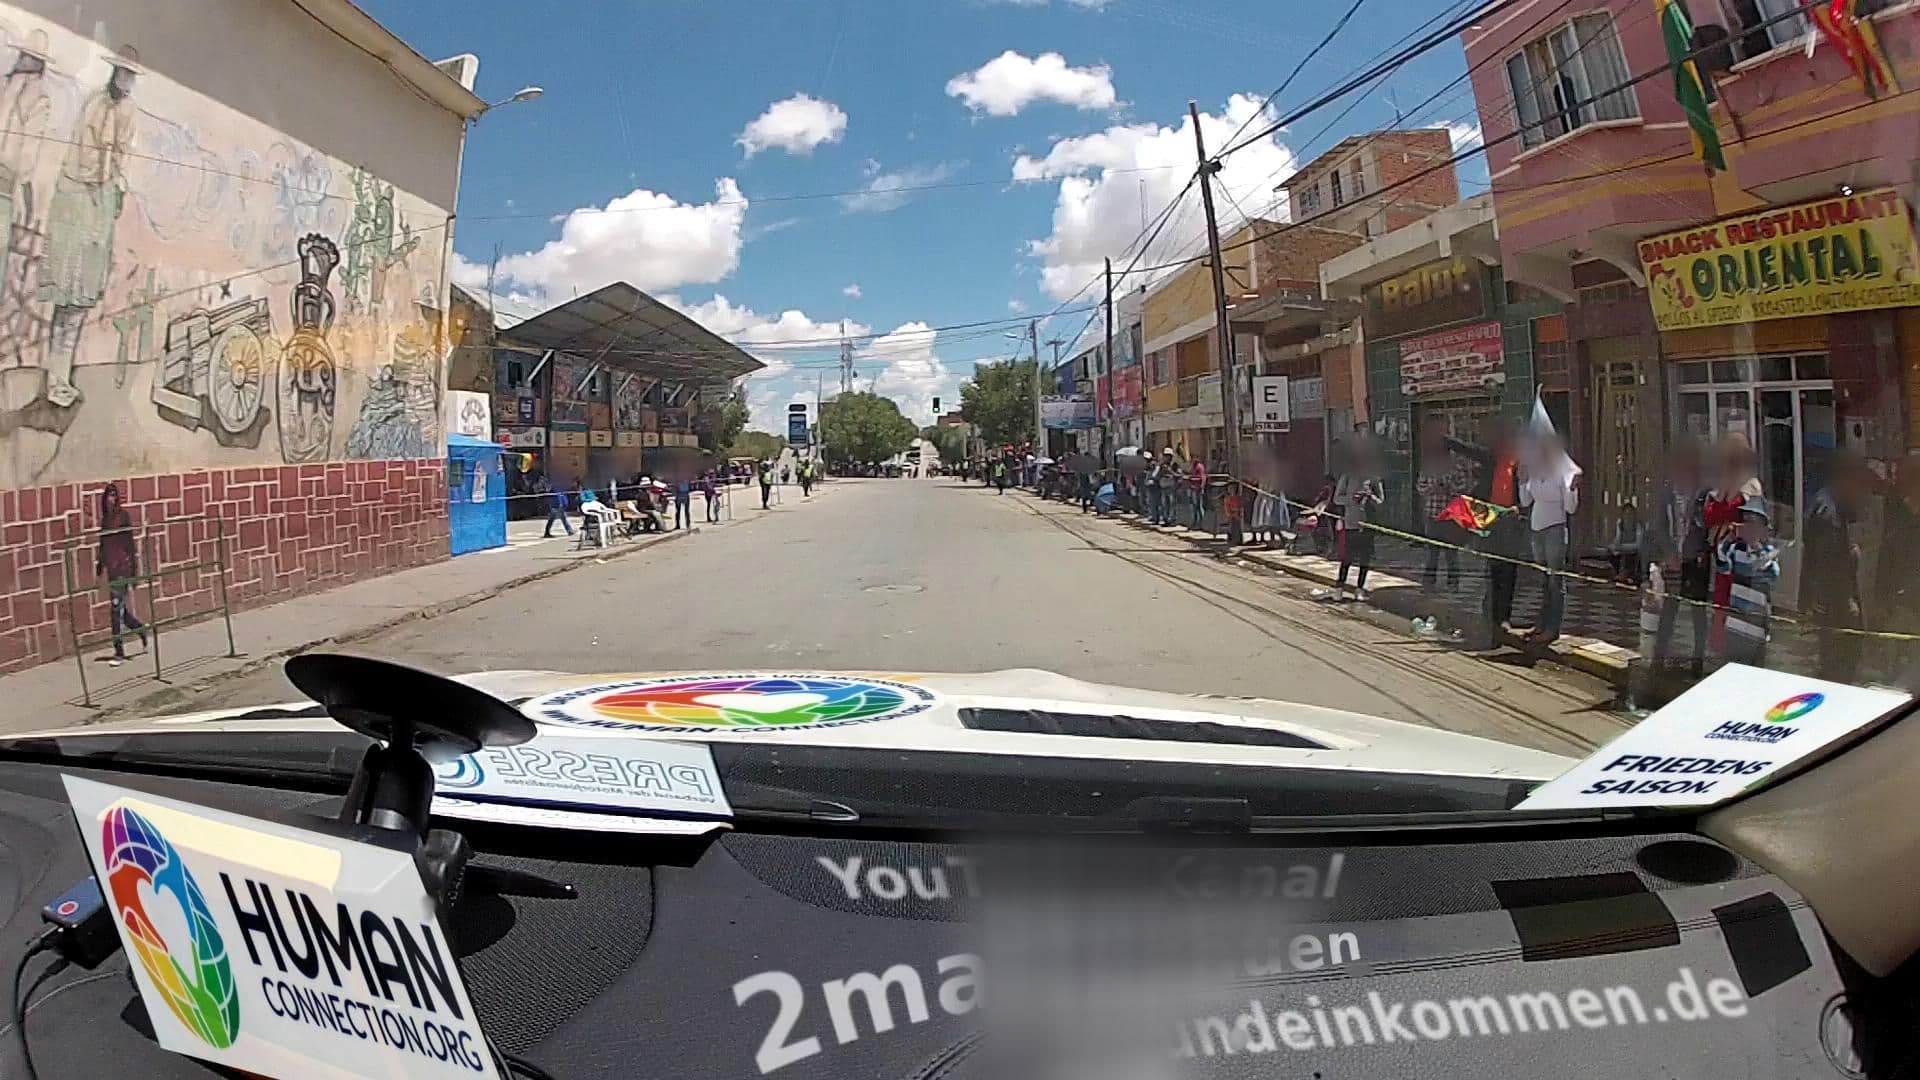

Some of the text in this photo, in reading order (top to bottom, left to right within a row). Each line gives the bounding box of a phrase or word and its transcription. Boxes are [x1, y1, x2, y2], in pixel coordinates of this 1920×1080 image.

[1641, 193, 1898, 264] SNACK RESTAURANT
[1691, 229, 1882, 302] ORIENTAL
[1263, 385, 1278, 403] E
[1711, 719, 1800, 739] HUMAN
[1581, 779, 1719, 795] SAISON.
[1600, 754, 1774, 776] FRIEDENS
[815, 853, 984, 902] YouT
[218, 871, 465, 1021] HUMAN
[261, 974, 484, 1073] CONNECTION.ORG
[733, 950, 988, 1074] 2ma
[1176, 967, 1749, 1058] undeinkommen.de
